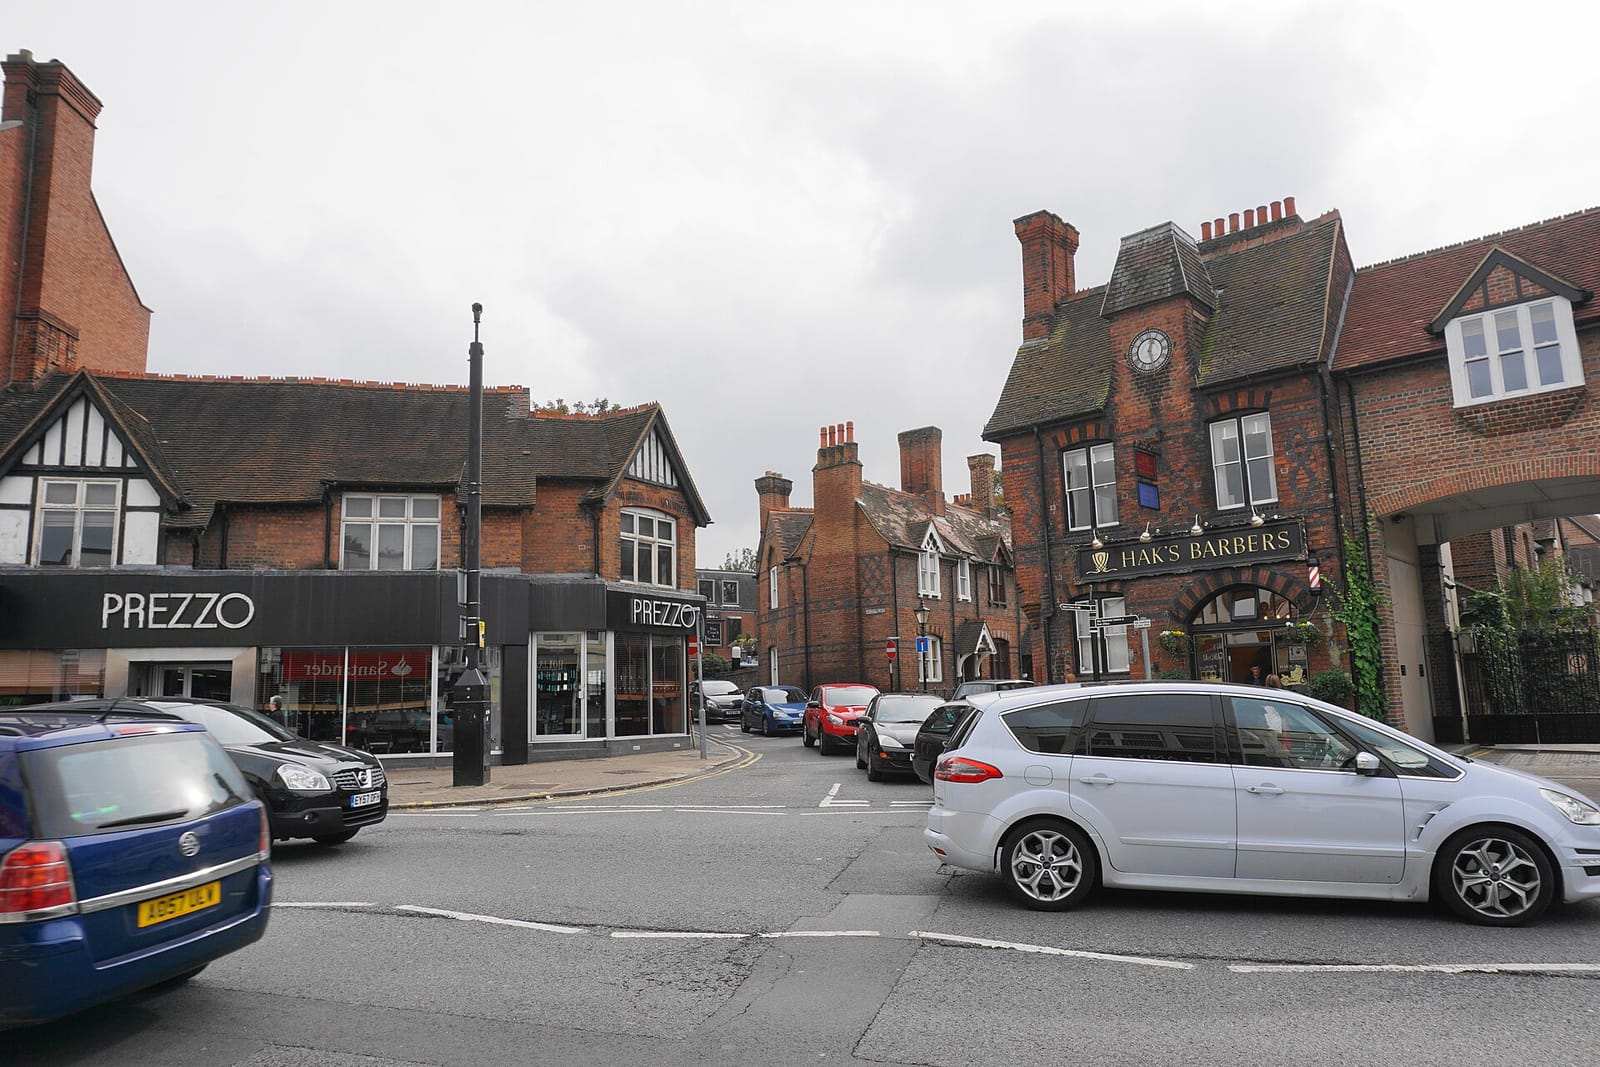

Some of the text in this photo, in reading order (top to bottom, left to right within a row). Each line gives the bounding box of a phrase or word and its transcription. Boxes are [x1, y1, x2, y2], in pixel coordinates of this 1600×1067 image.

[1121, 530, 1291, 568] HAK'S BARBERS
[101, 592, 255, 629] PREZZO
[633, 598, 696, 628] PREZZO
